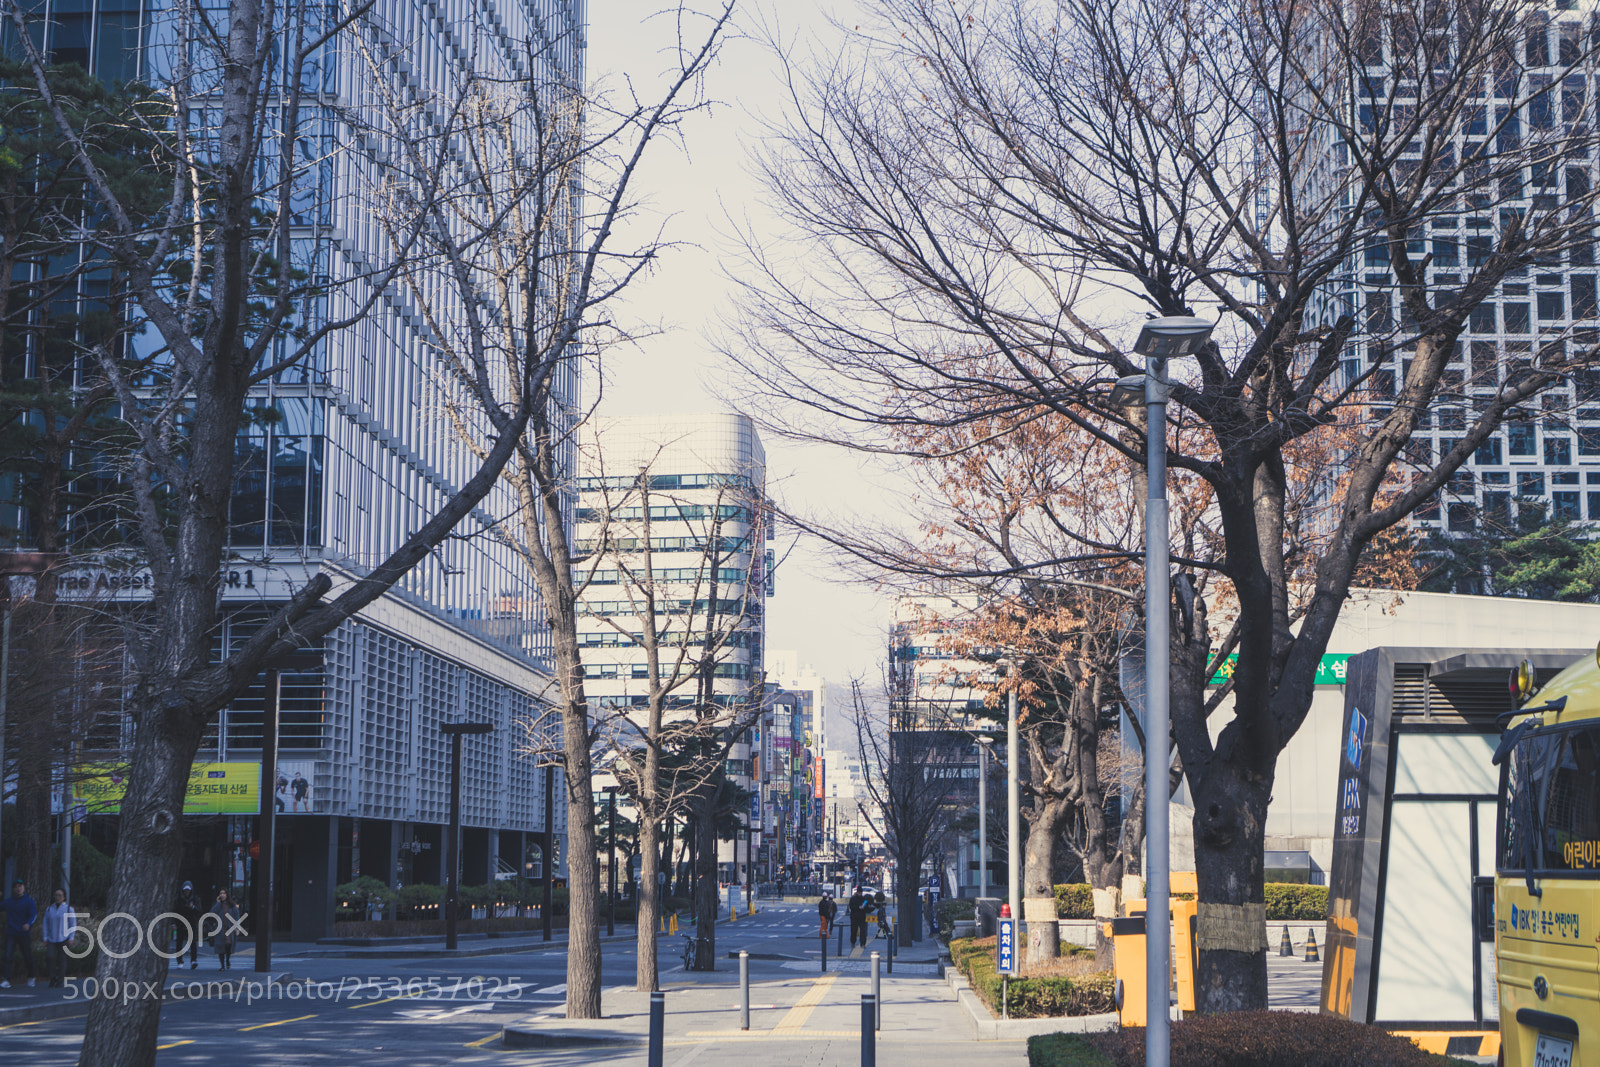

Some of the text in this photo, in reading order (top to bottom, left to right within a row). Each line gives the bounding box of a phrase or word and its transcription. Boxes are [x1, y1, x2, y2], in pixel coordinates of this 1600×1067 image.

[1331, 660, 1348, 678] 쉼
[1342, 778, 1361, 810] IBK
[1519, 909, 1531, 931] IBK
[1541, 910, 1554, 935] 좋은
[1554, 912, 1579, 939] 어린이집
